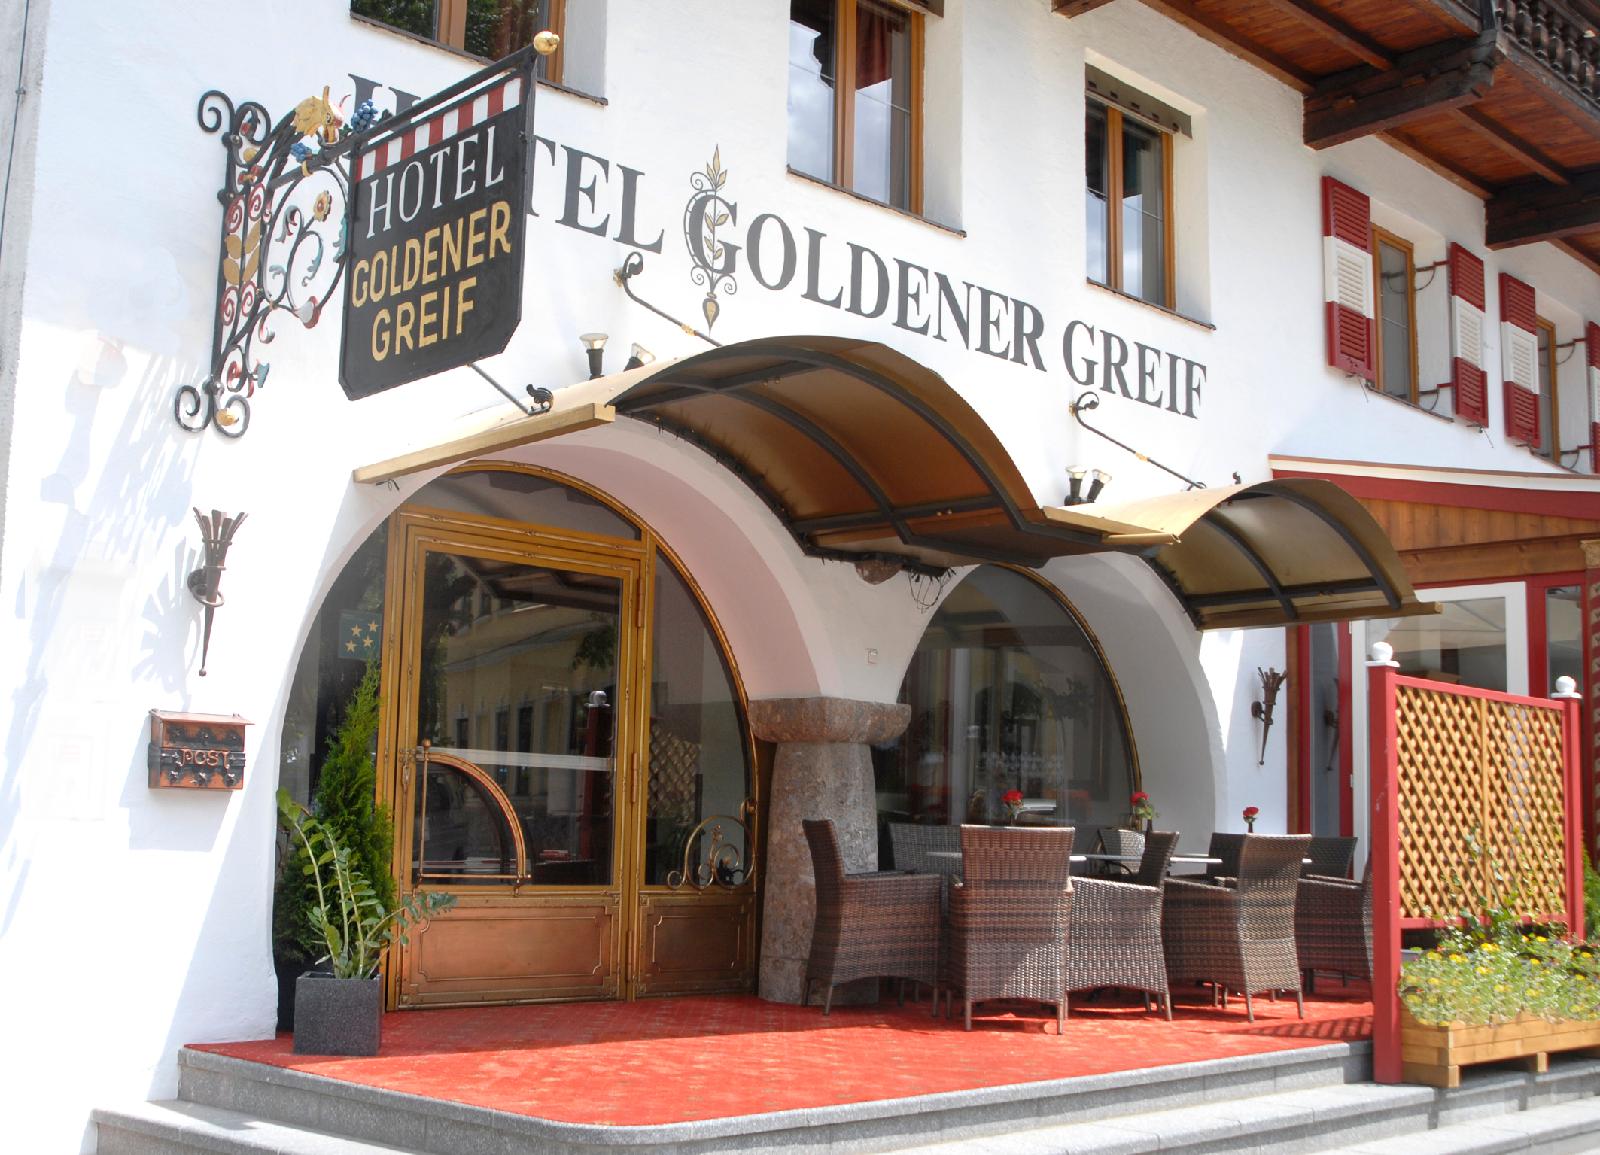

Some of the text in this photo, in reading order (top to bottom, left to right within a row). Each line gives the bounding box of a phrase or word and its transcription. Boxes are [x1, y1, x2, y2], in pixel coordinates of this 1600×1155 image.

[366, 125, 504, 239] HOTEL
[348, 73, 1207, 420] TEL GOLDENER GREIF
[352, 201, 511, 308] GOLDENER
[371, 277, 477, 361] GREIF
[180, 748, 231, 769] POST
